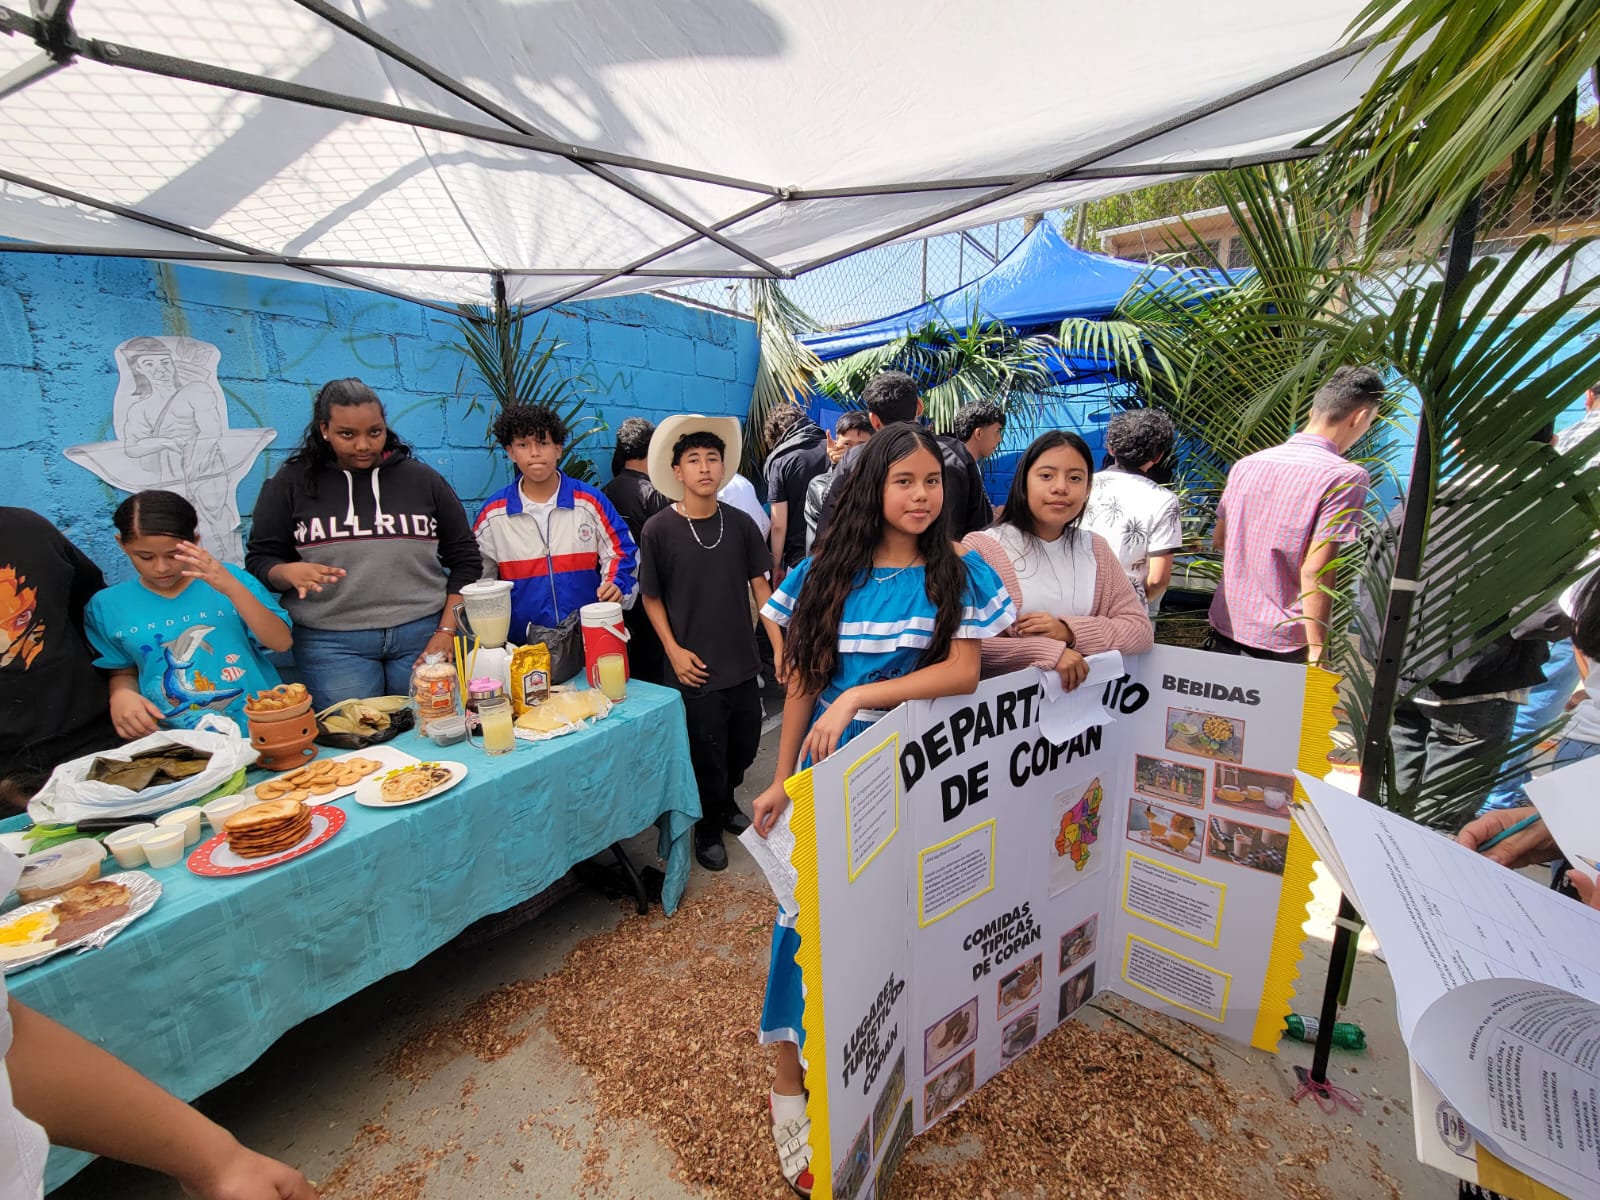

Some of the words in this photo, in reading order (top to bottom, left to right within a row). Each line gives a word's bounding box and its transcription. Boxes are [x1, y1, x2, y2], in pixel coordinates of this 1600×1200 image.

[1162, 674, 1261, 706] BEBIDAS
[940, 760, 989, 823] DE
[963, 901, 1030, 951] COMIDAS
[972, 957, 991, 981] DE
[843, 971, 895, 1066] LUGARES
[865, 1036, 880, 1073] DE
[1487, 1056, 1496, 1099] CRITERIO
[1514, 1045, 1525, 1121] DEPARTAMENTO
[1519, 1124, 1528, 1142] DEL
[1581, 1101, 1593, 1148] CHAMPAS
